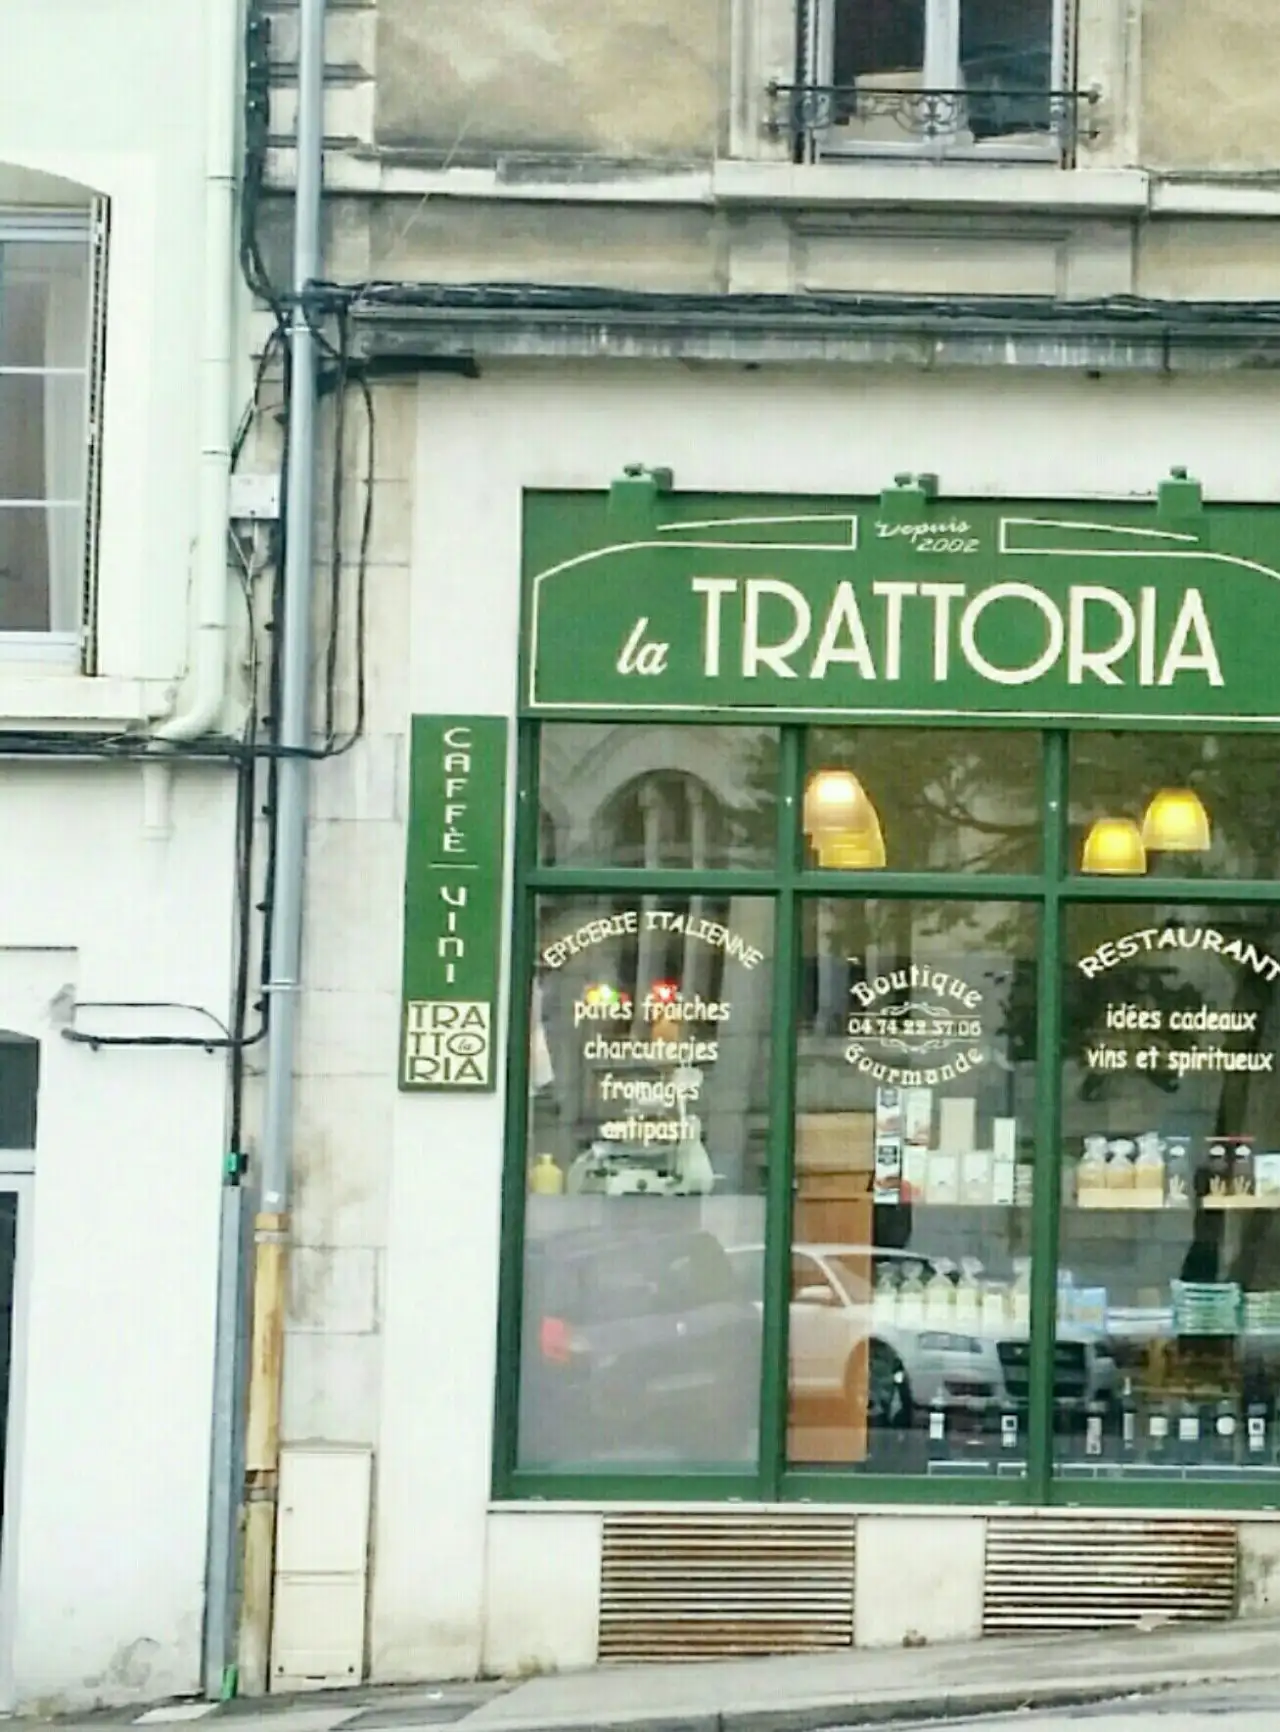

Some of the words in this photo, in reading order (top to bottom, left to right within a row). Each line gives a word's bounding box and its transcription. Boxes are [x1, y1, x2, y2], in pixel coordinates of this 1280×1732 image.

[916, 537, 980, 553] 2002
[615, 617, 668, 675] la
[691, 577, 1224, 687] TRATTORIA
[541, 912, 638, 968] EPICERIE
[646, 911, 764, 970] ITALIENNE
[850, 964, 983, 1008] Boutique
[1106, 1003, 1161, 1029] idées
[1169, 1004, 1257, 1032] cadeaux
[584, 1034, 719, 1061] charcuteries
[845, 1043, 983, 1085] Gourmande
[1087, 1044, 1127, 1069] vins
[1136, 1046, 1160, 1070] et
[1168, 1045, 1274, 1078] spiritueux
[601, 1072, 699, 1107] fromages
[600, 1115, 695, 1147] antipasti
